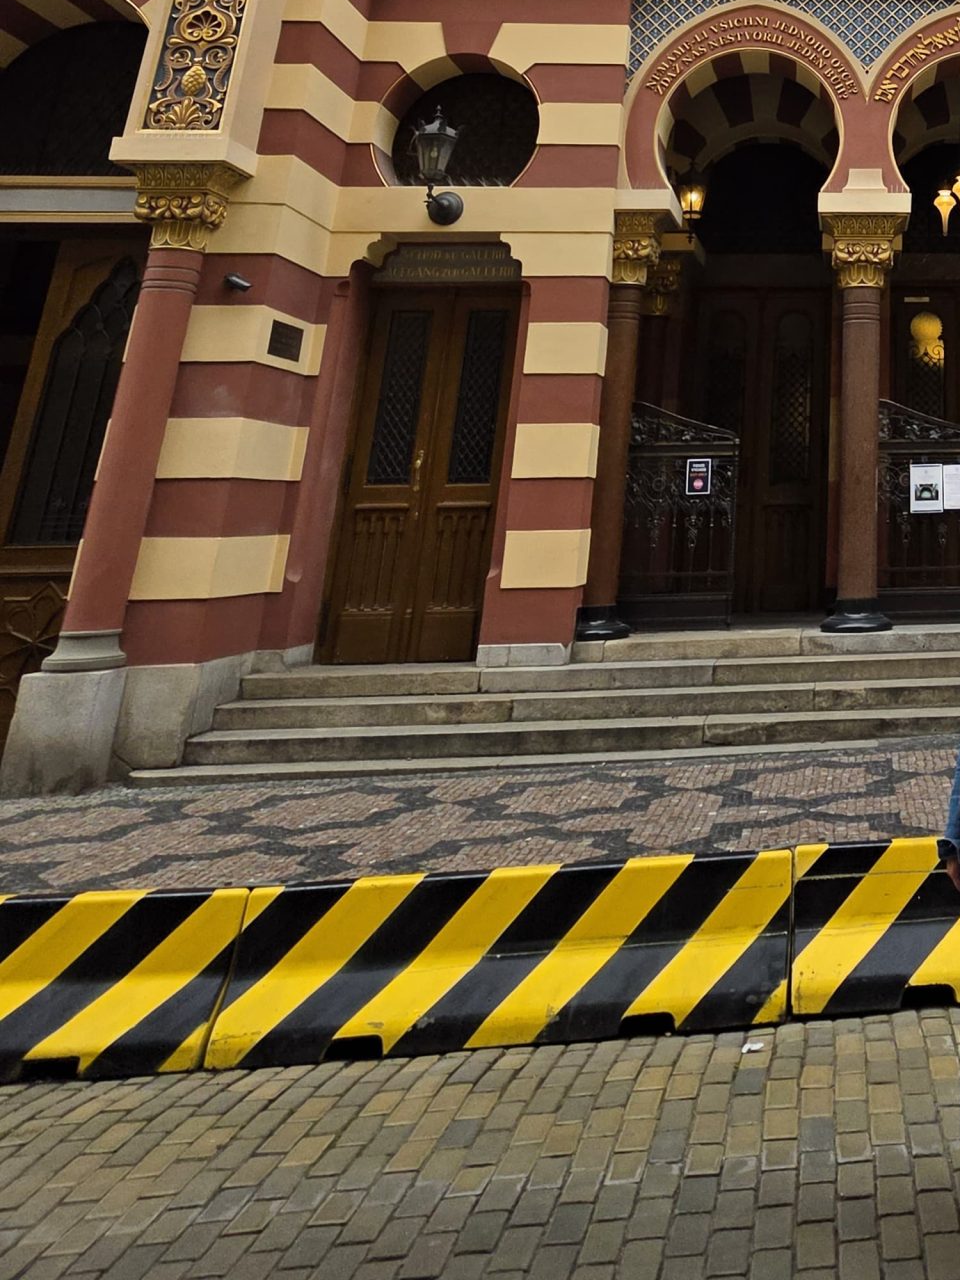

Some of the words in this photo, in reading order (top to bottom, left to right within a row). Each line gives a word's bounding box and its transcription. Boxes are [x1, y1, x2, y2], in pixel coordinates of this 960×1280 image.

[772, 20, 832, 59] JEDNOHO
[831, 58, 859, 94] OTCE?
[787, 40, 827, 69] JEDEN
